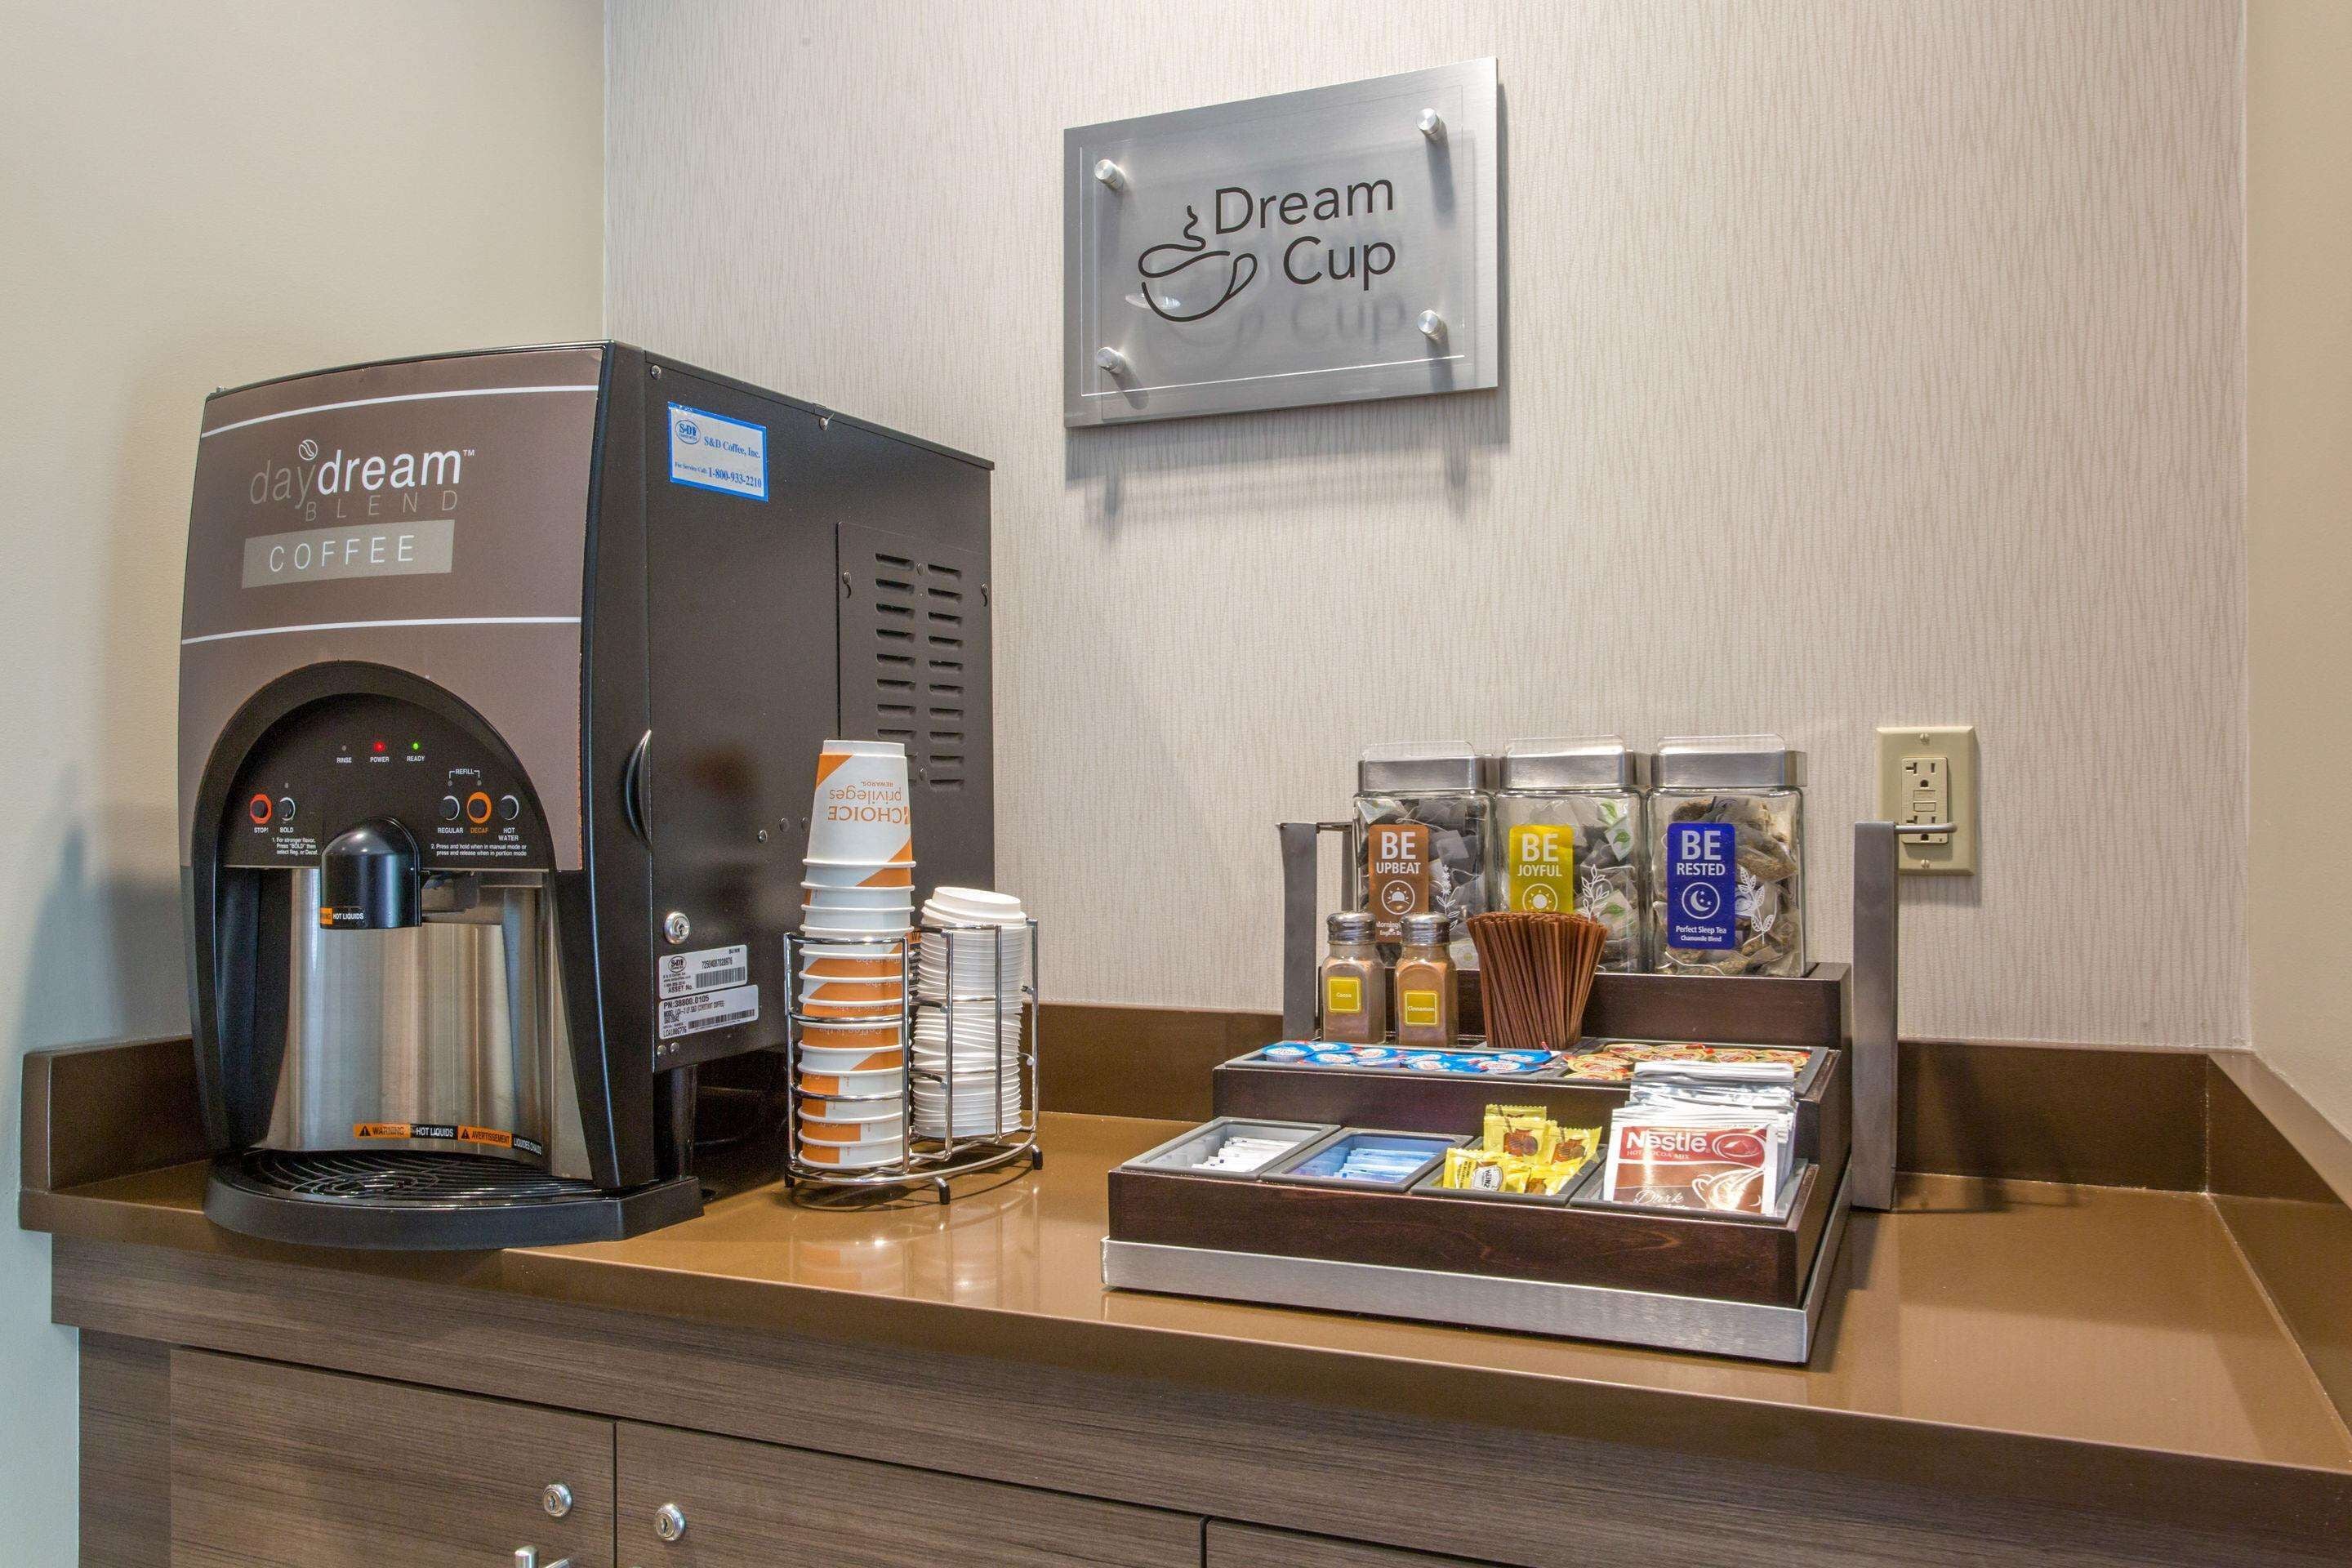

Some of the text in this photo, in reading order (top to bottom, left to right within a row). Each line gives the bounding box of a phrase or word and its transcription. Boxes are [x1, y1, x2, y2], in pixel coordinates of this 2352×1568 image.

[1215, 179, 1394, 234] Dream
[1283, 236, 1396, 292] Cup
[704, 436, 721, 450] S&D
[723, 439, 746, 456] Coffee,
[748, 447, 761, 459] Inc.
[708, 467, 762, 488] 1-800-933-2210
[305, 490, 458, 522] BLEND
[270, 535, 415, 572] COFFEE
[829, 786, 902, 804] privileges
[827, 806, 902, 824] CHOICE
[1381, 831, 1416, 860] BE
[1521, 833, 1559, 862] BE
[1682, 830, 1722, 861] BE
[1376, 862, 1421, 875] UPBEAT
[1517, 864, 1562, 877] JOYFUL
[1677, 862, 1726, 875] RESTED
[1675, 925, 1726, 934] Perfect Sleep Tea
[668, 986, 684, 994] ASSET
[372, 1126, 404, 1135] WARNING
[416, 1126, 430, 1136] HOT
[430, 1128, 454, 1138] LIQUIDS
[471, 1129, 510, 1144] AVERTISSEMENT
[1482, 1169, 1491, 1188] HEINZ
[1633, 1187, 1685, 1205] Dark
